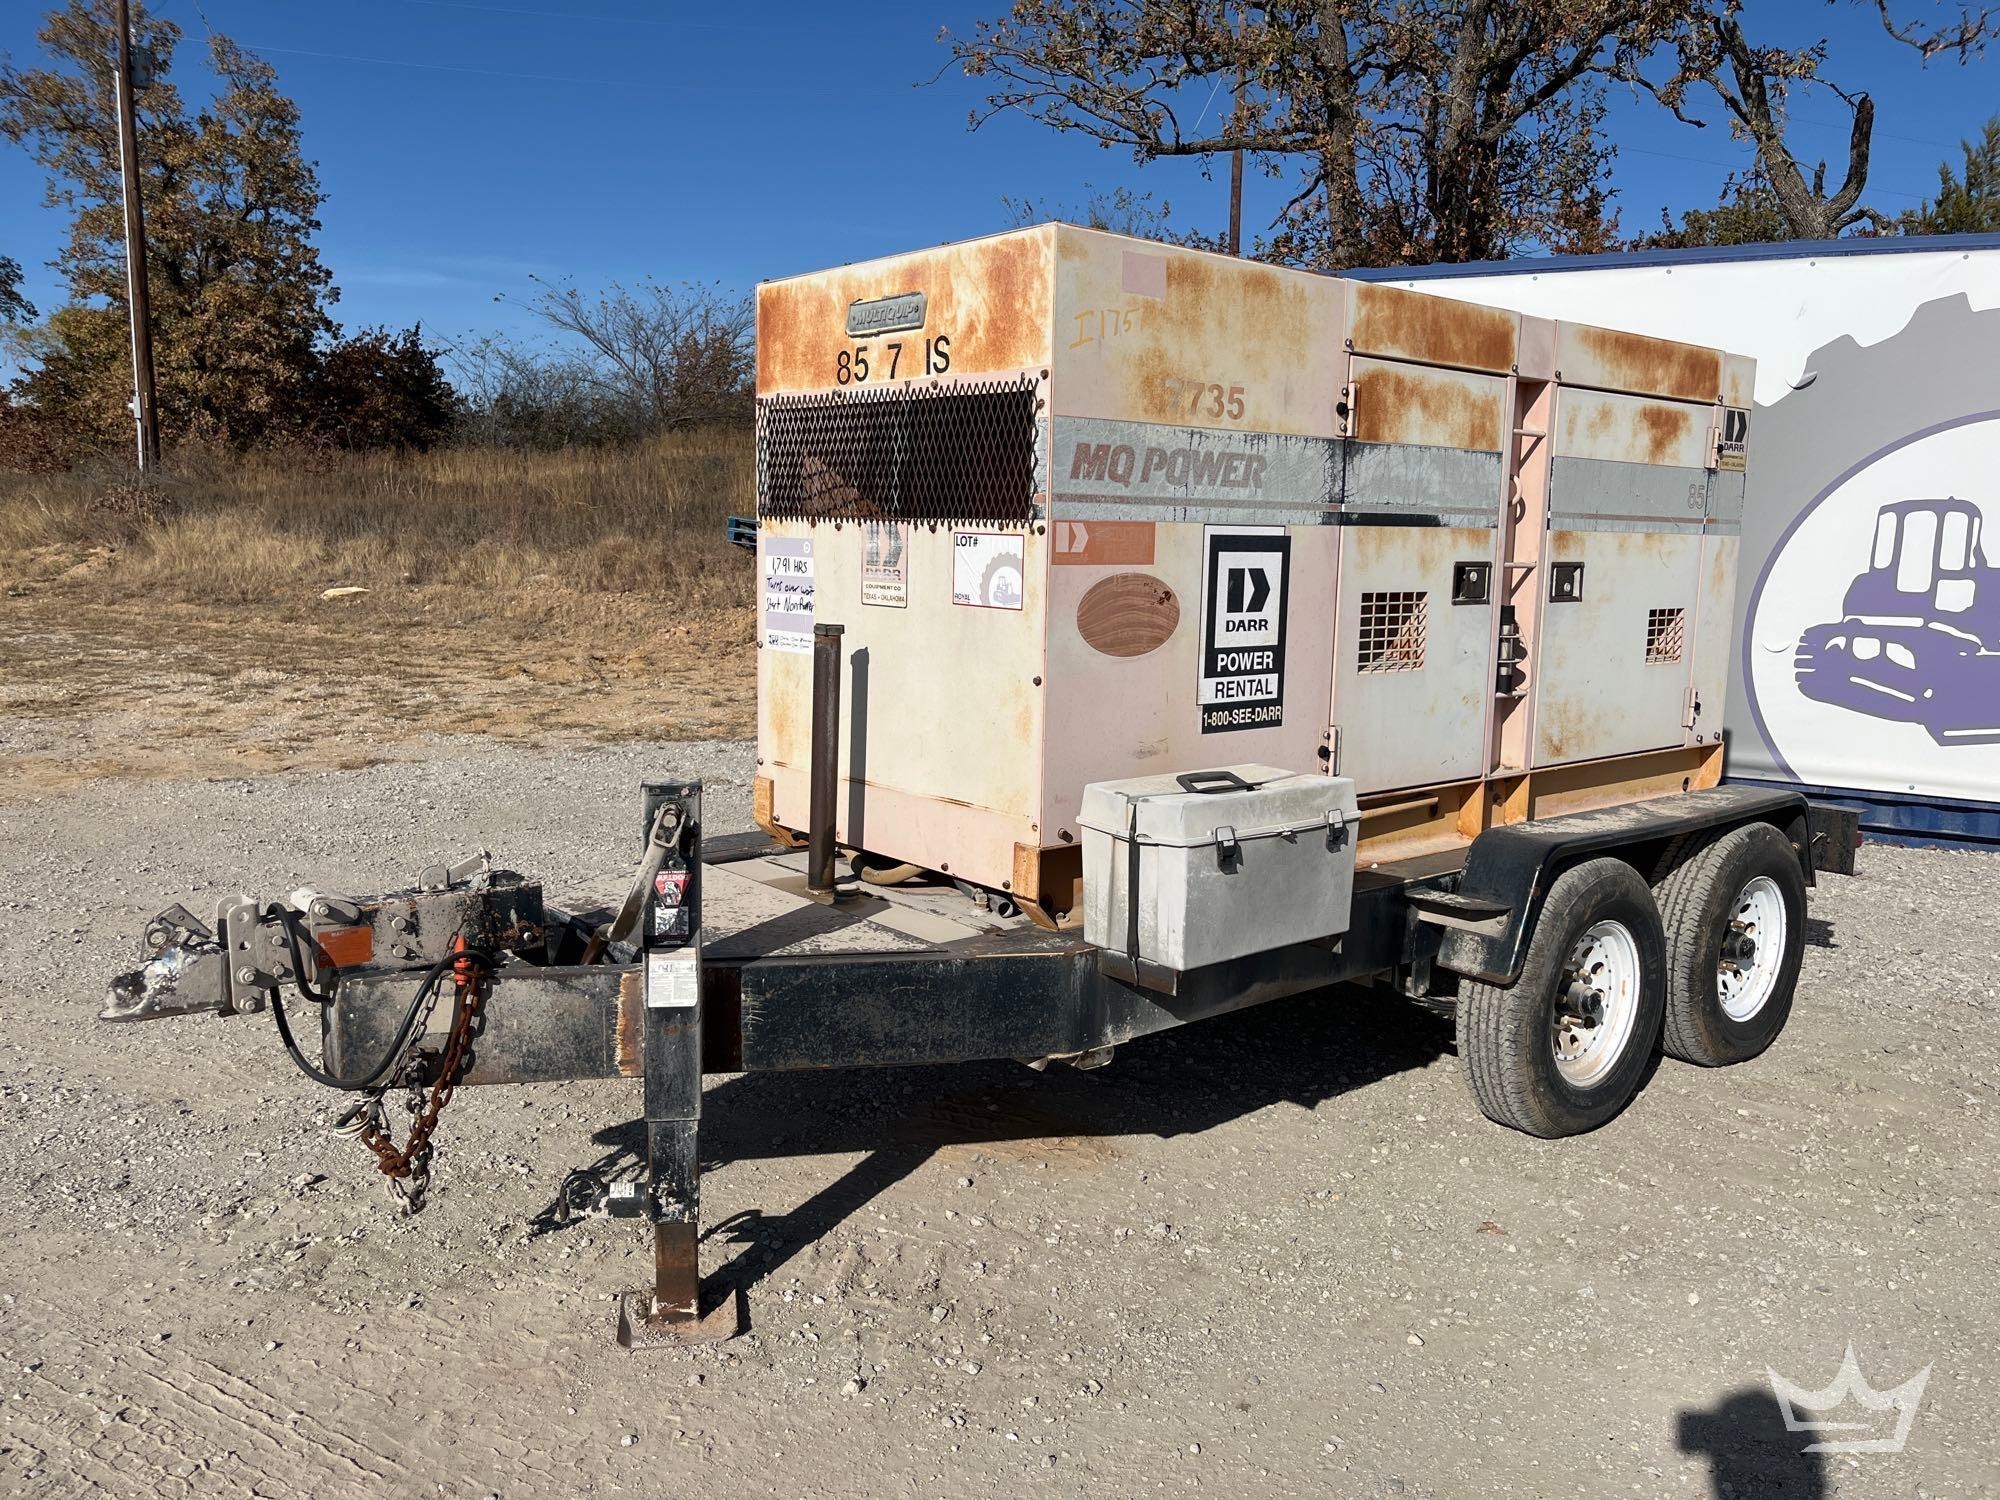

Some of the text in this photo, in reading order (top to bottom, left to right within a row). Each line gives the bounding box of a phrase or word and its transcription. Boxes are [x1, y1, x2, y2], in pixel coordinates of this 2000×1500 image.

[856, 304, 915, 325] MULTIQUIP
[1724, 442, 1745, 453] DARR
[1070, 443, 1268, 489] MQ POWER
[955, 535, 979, 547] LOT#
[794, 559, 808, 574] HRS
[1225, 618, 1269, 633] DARR
[1217, 651, 1274, 672] POWER
[1214, 678, 1273, 699] RENTAL
[1203, 705, 1282, 727] 1-800-SEE-DARR
